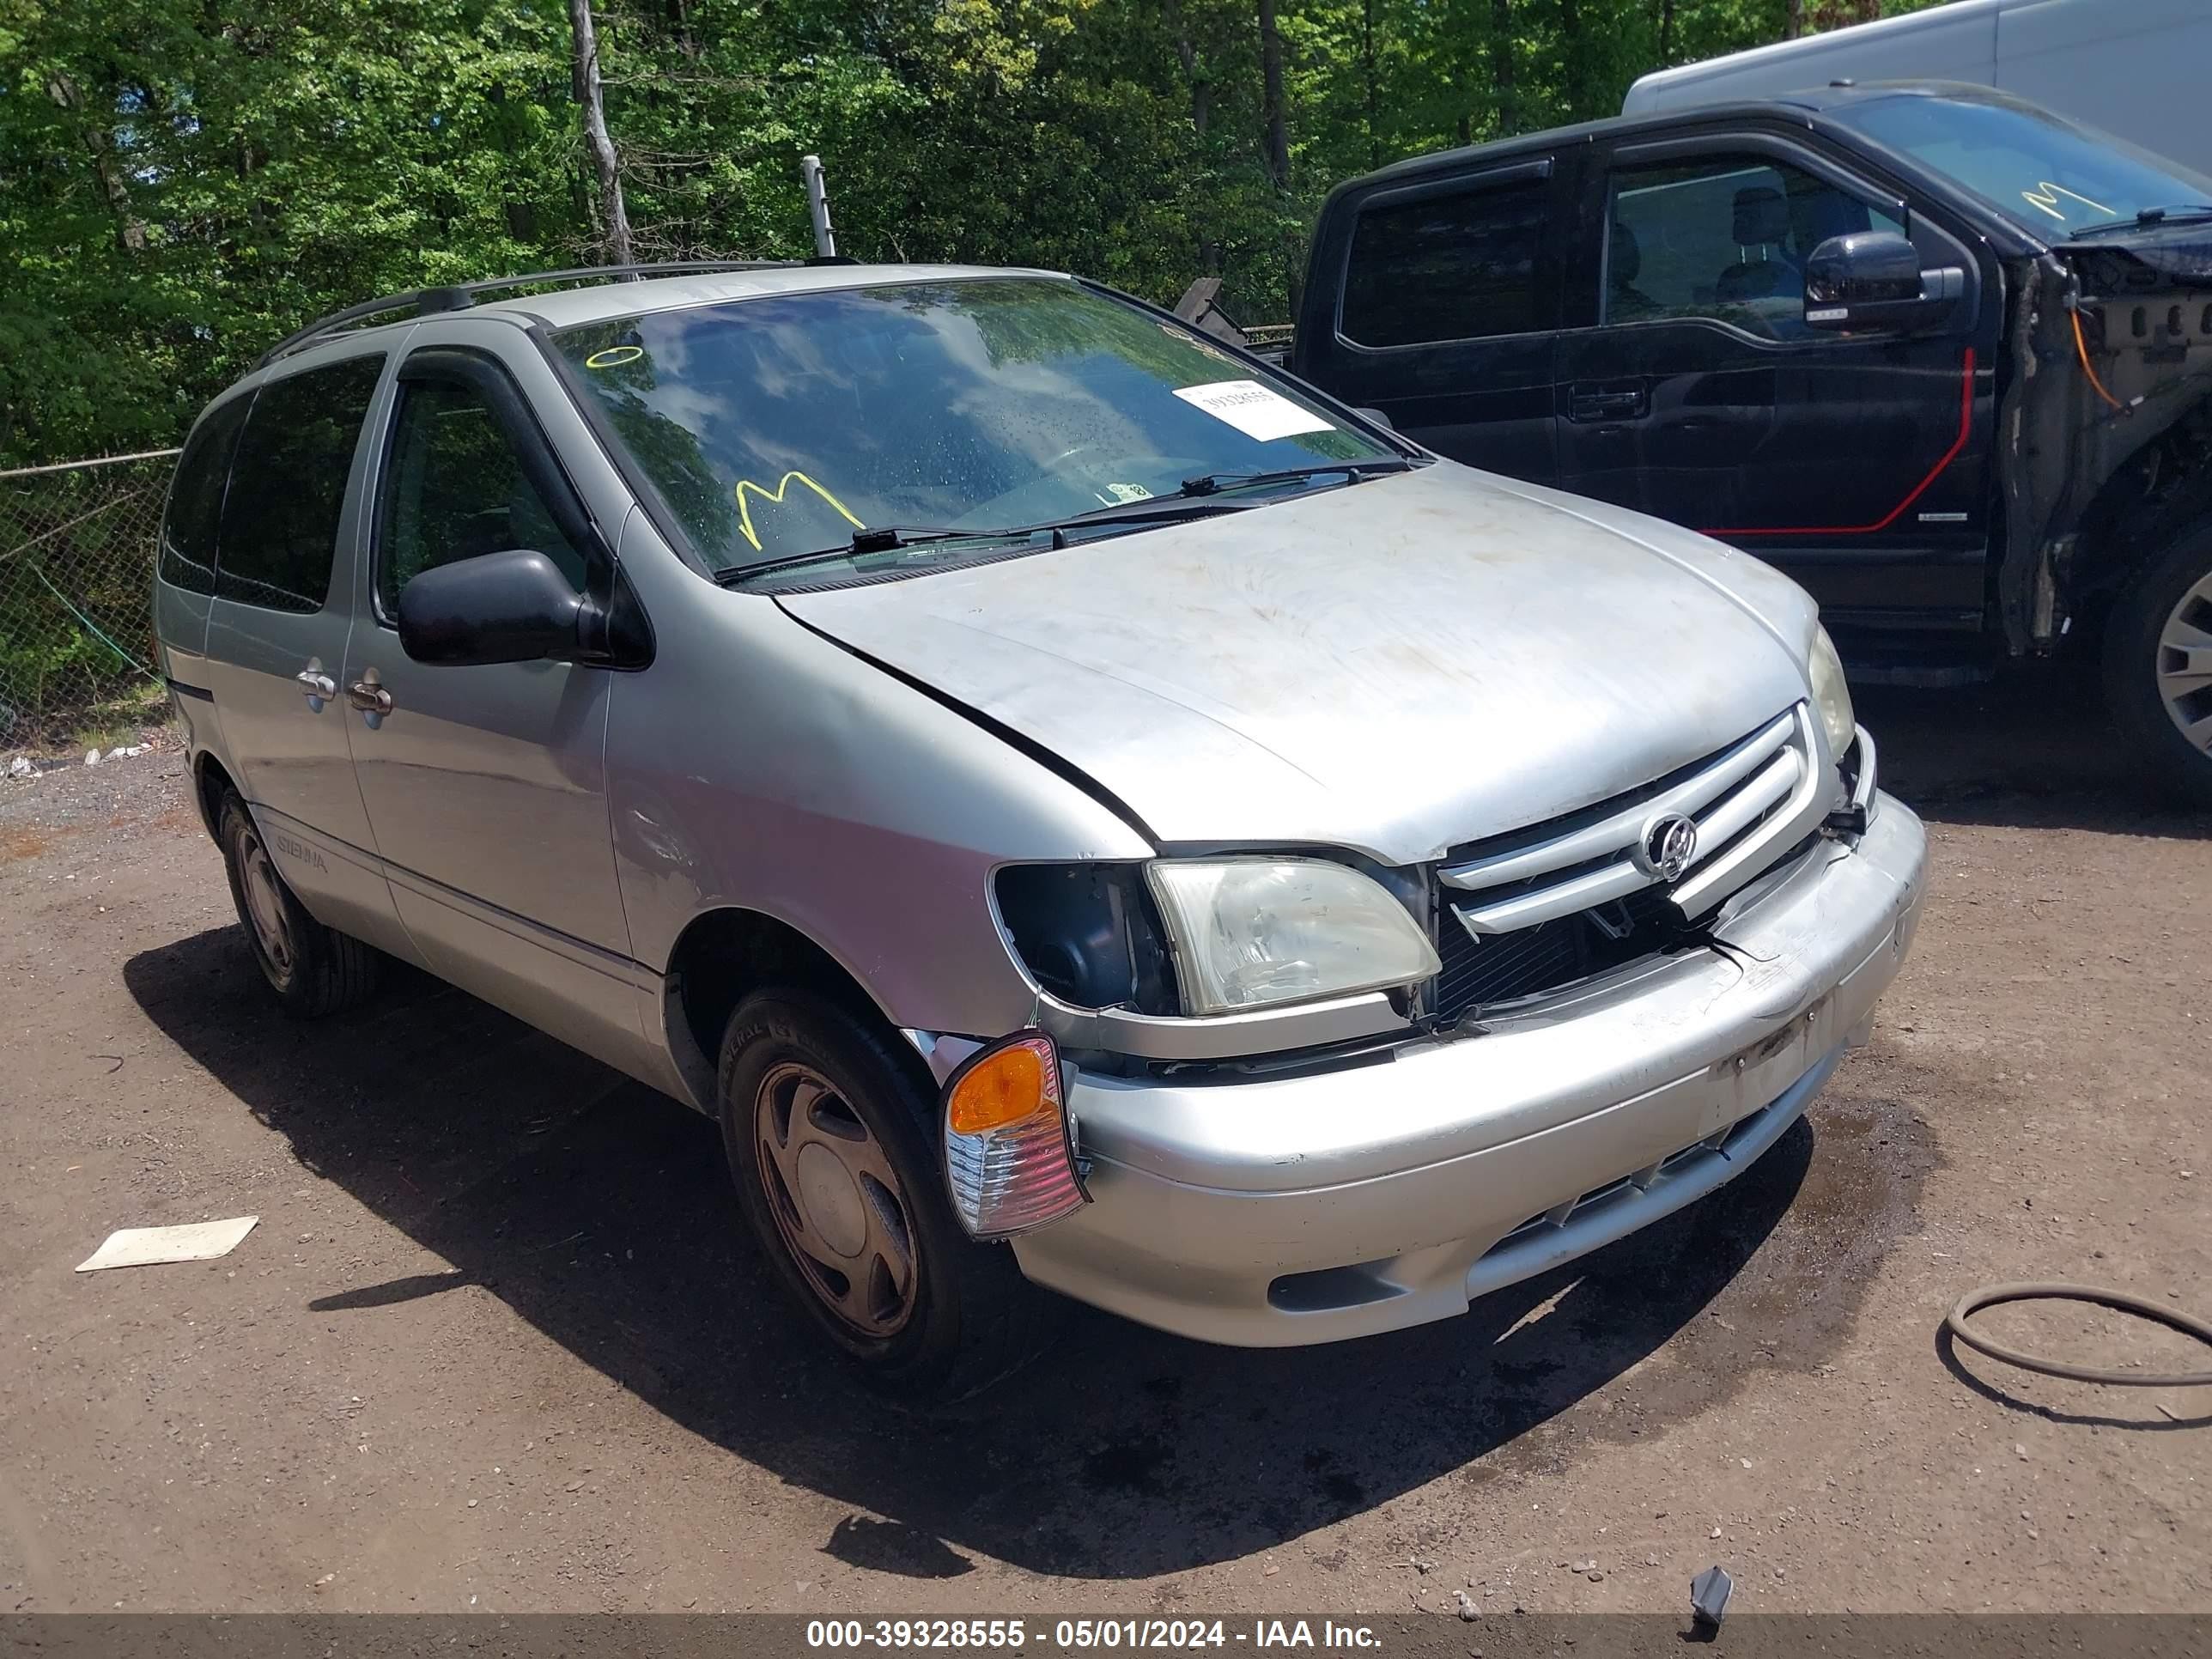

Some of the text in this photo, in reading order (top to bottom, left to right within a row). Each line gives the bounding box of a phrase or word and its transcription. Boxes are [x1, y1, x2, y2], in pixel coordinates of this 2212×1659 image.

[2021, 181, 2118, 221] M
[736, 471, 866, 550] M
[276, 836, 328, 873] SIENNA
